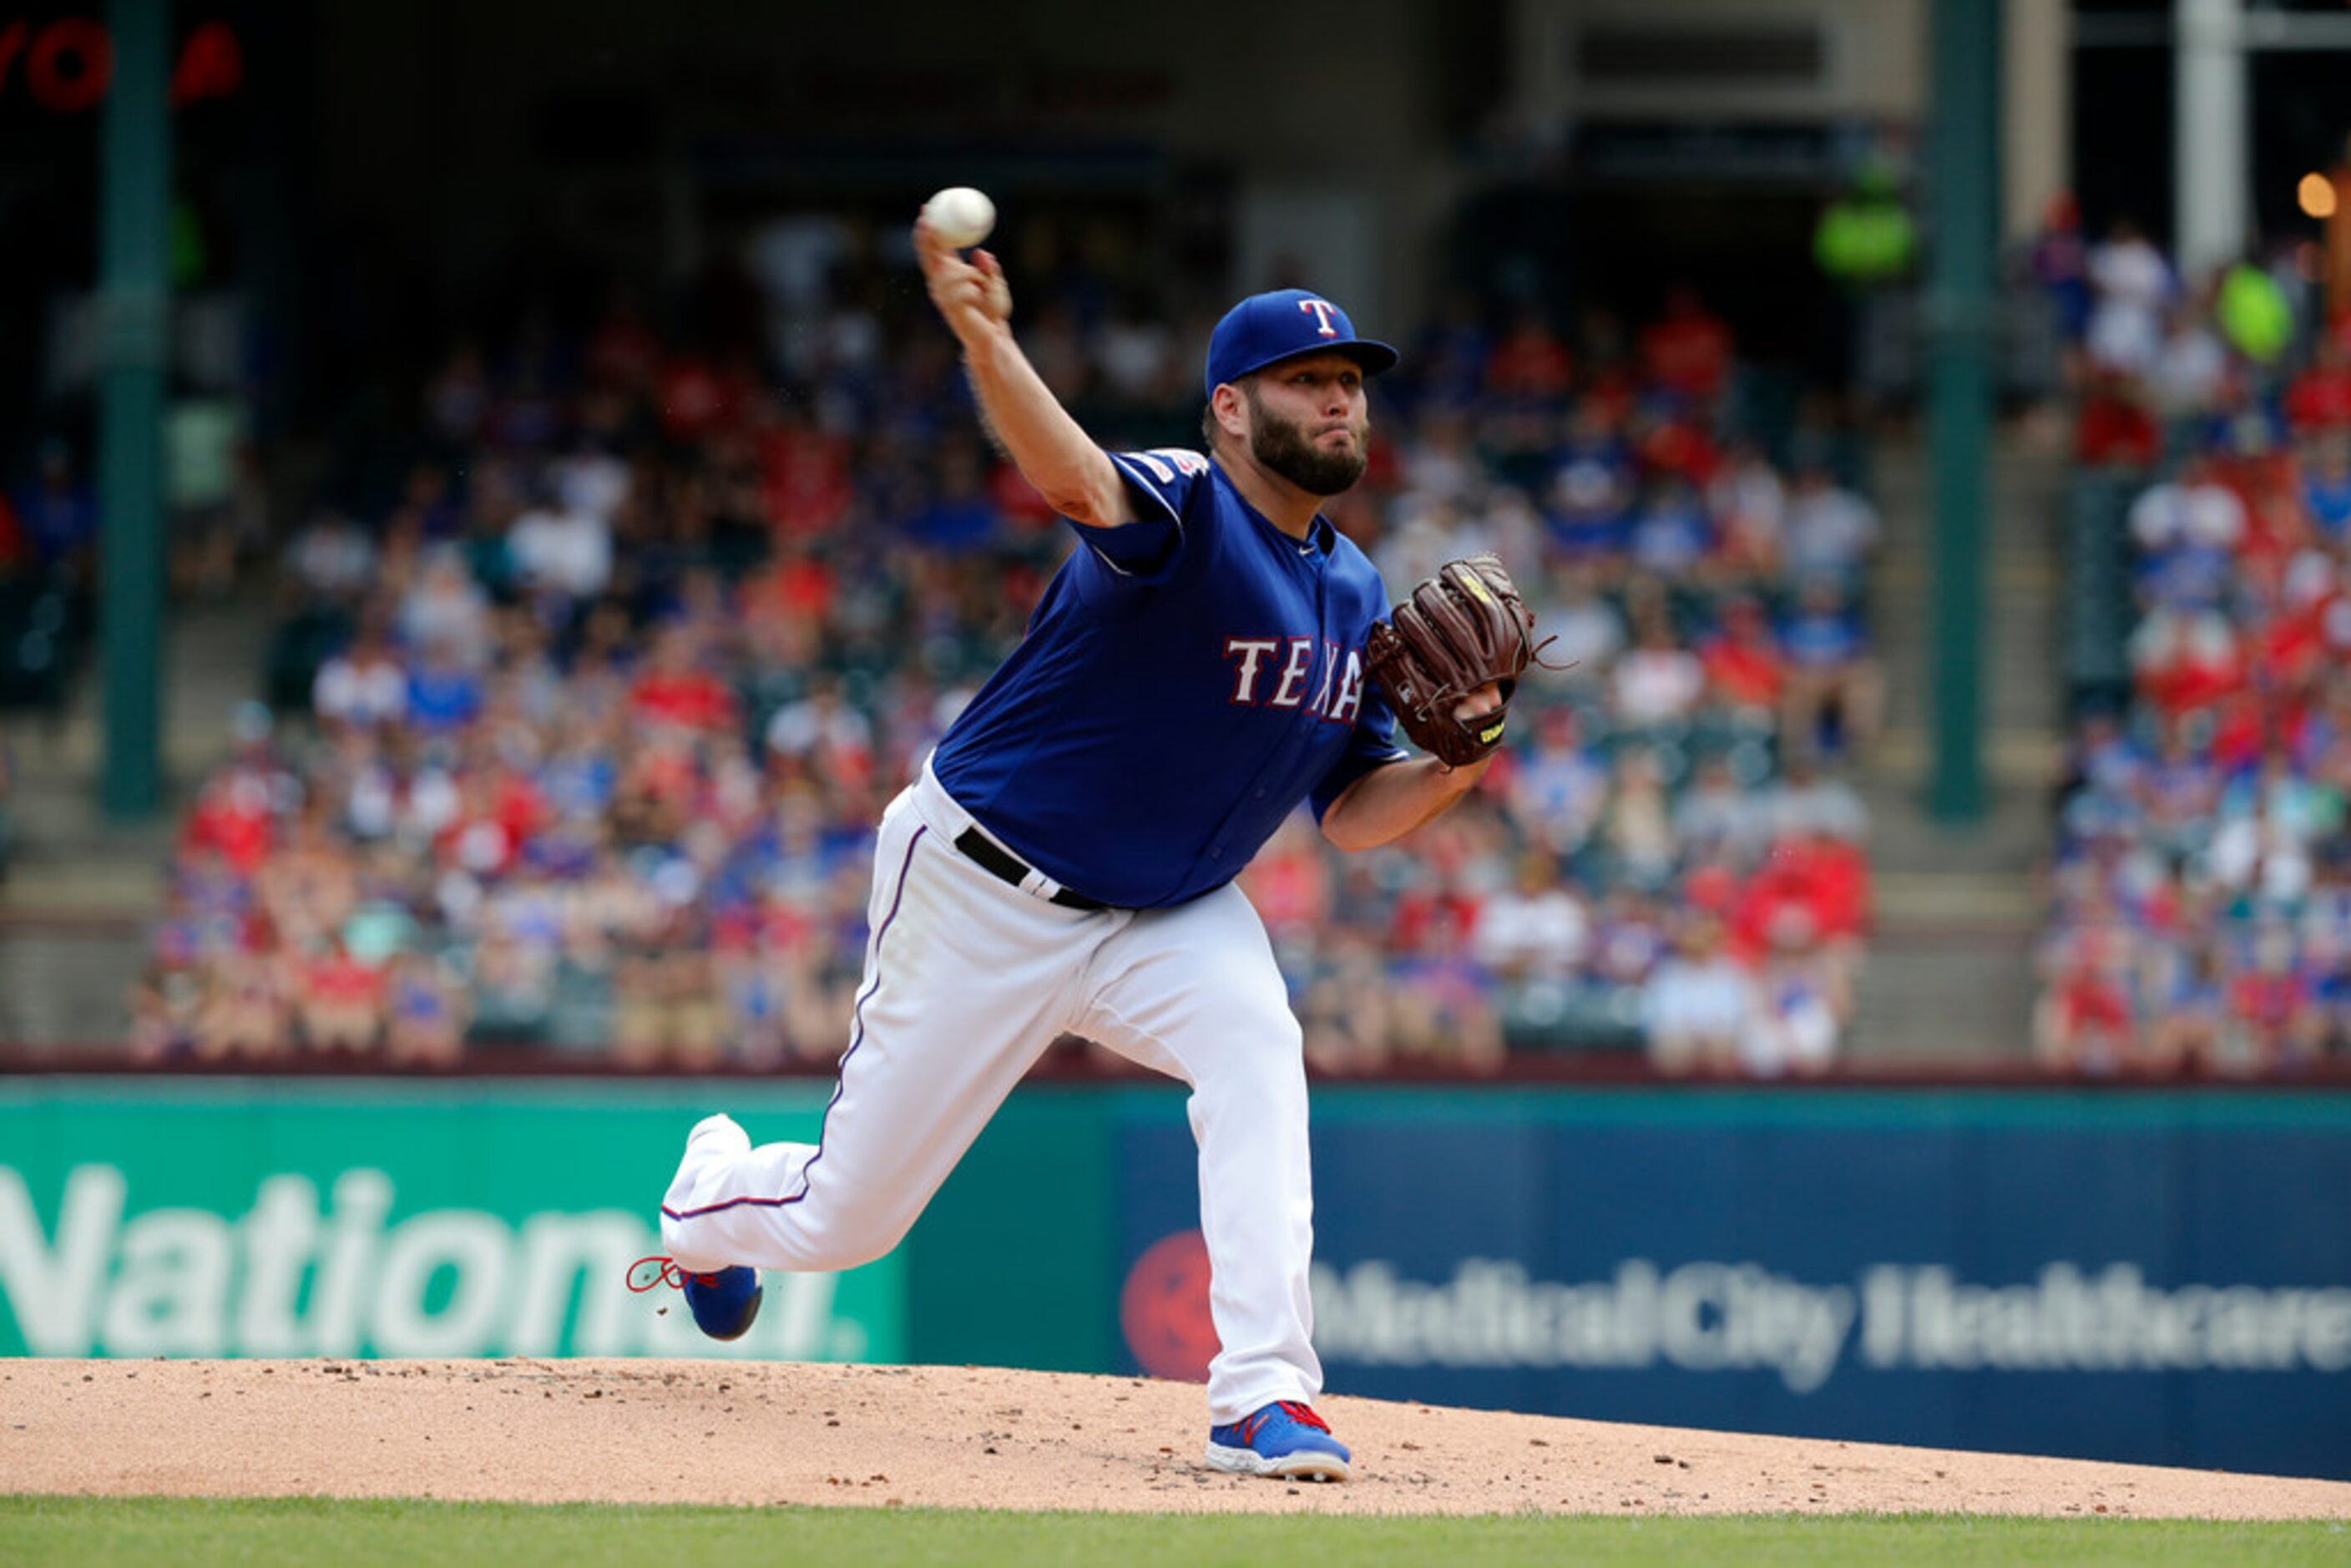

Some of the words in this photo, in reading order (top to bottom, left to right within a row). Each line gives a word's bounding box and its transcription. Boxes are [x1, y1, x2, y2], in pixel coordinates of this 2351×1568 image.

[0, 16, 244, 113] OA
[1298, 300, 1338, 338] T
[1222, 635, 1364, 724] TEXA
[0, 1163, 837, 1359] Nation
[1862, 1262, 2351, 1370] Healthcare
